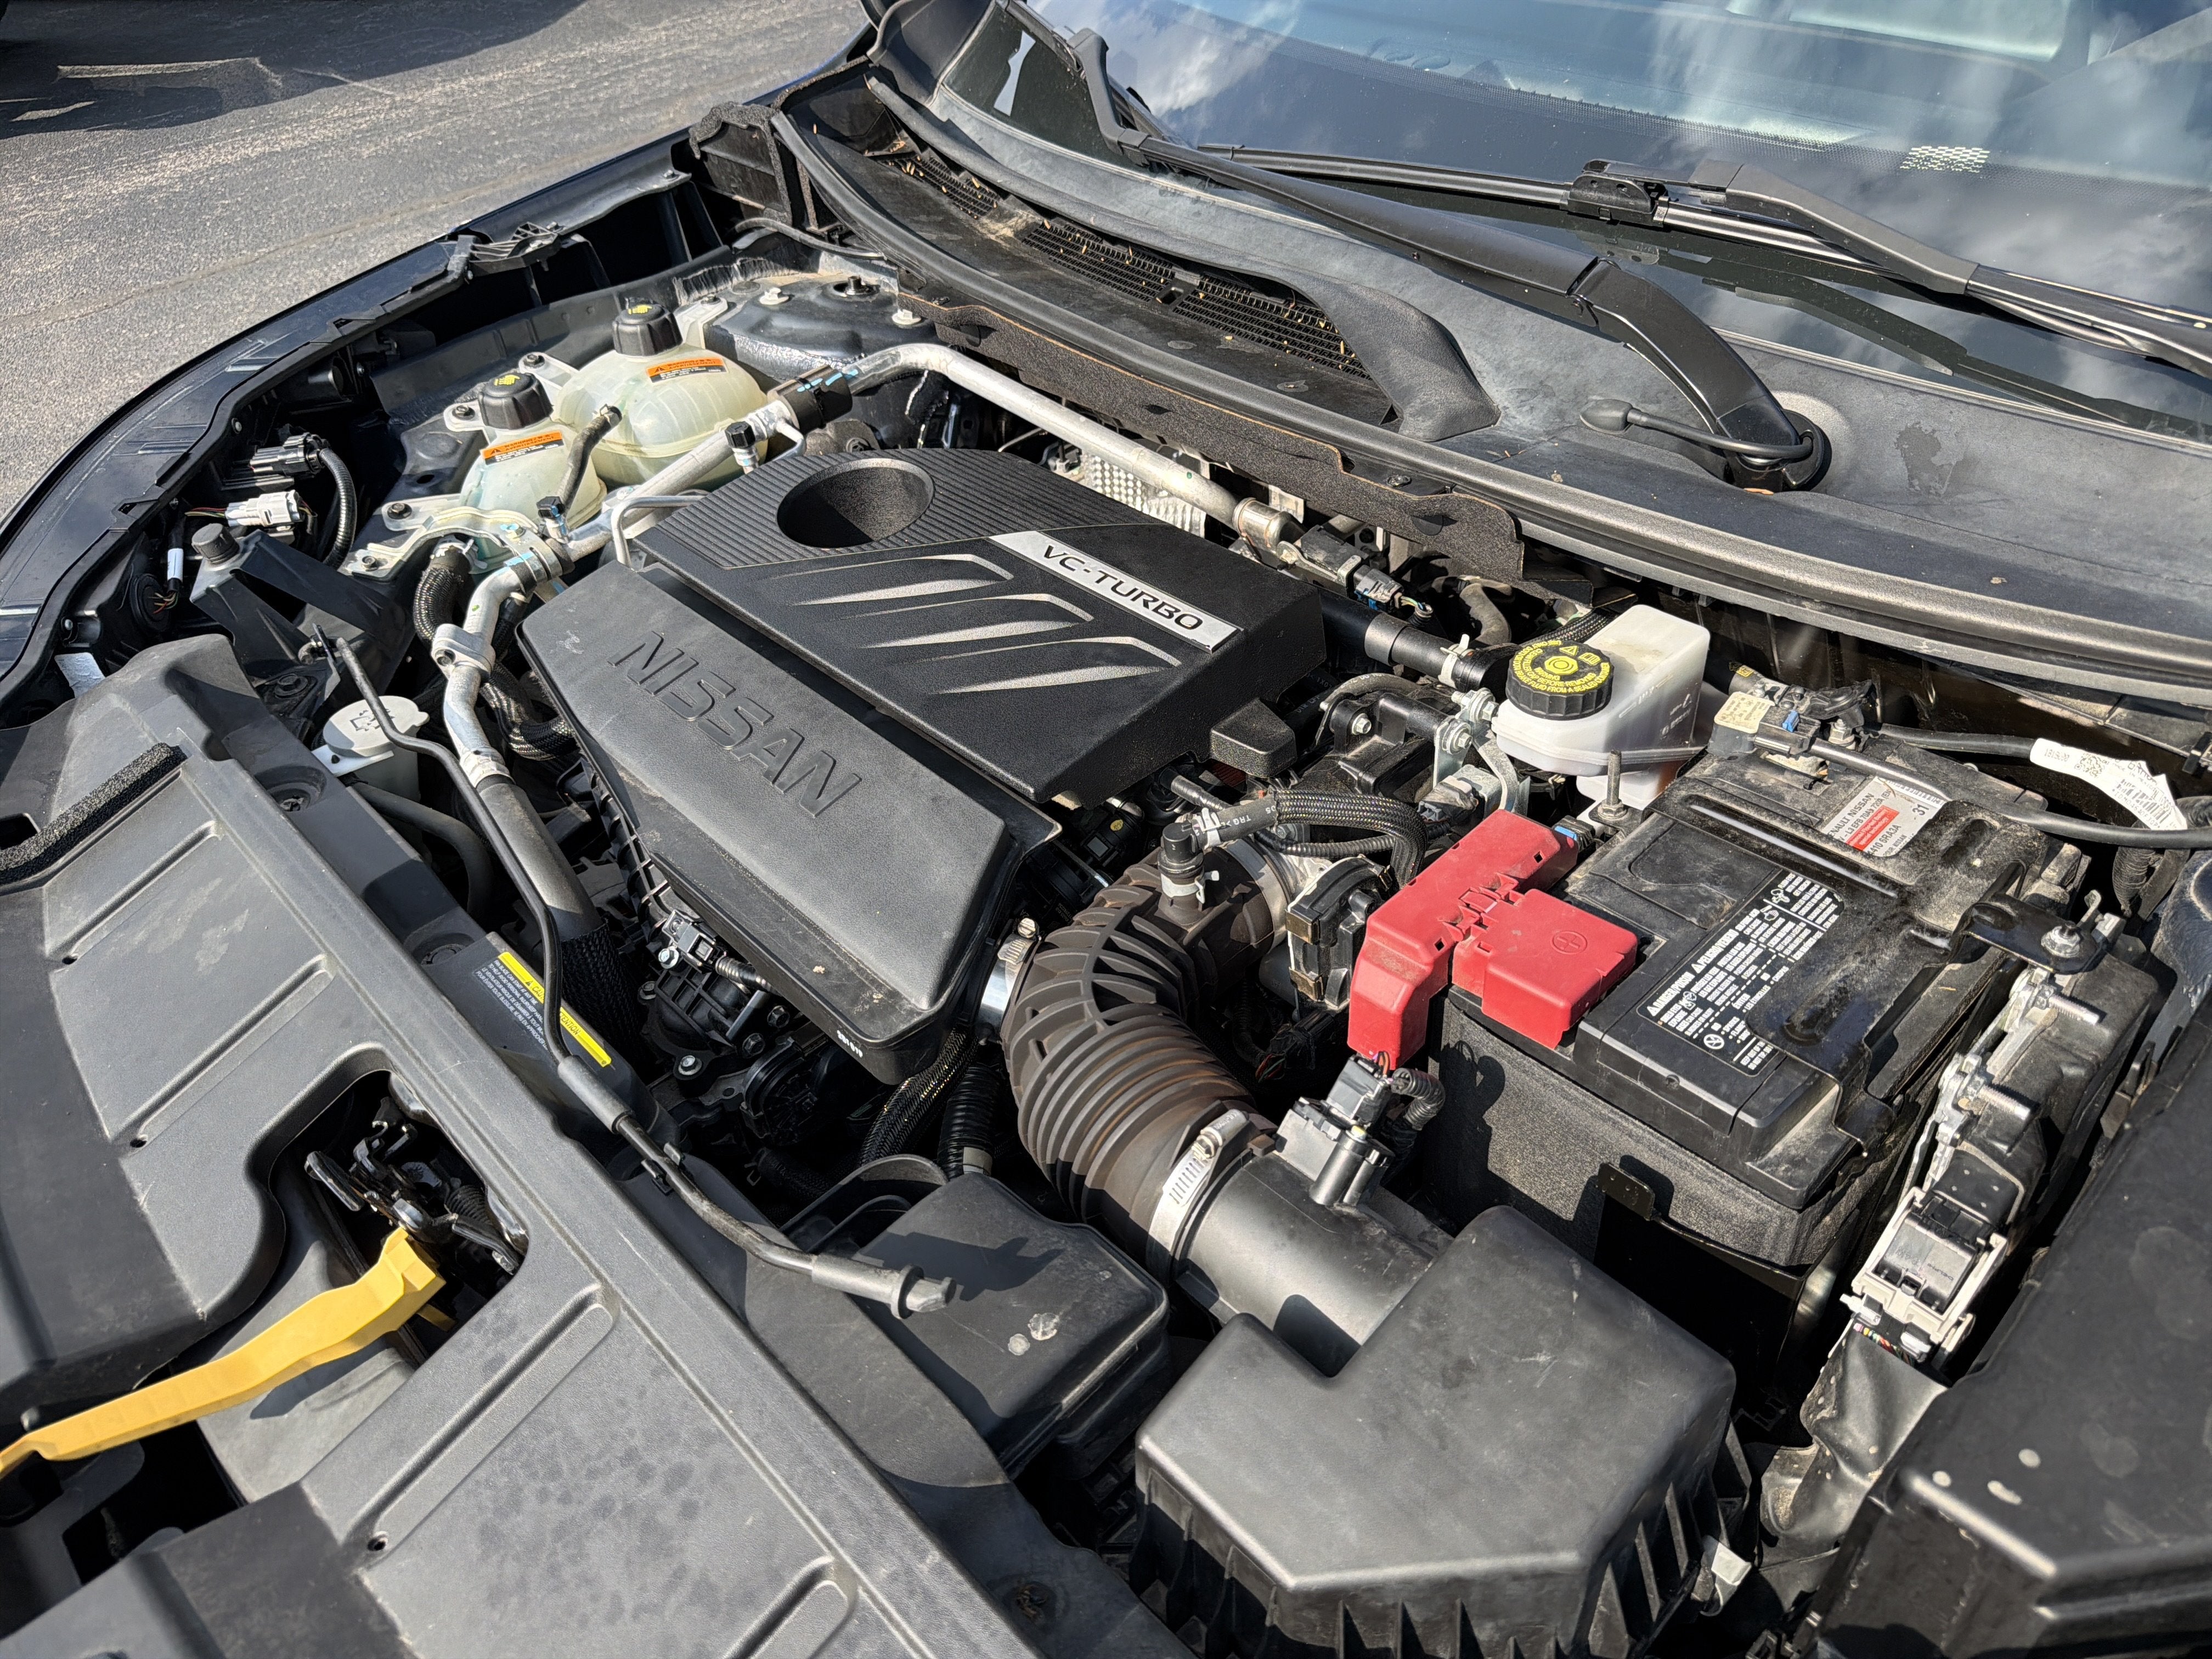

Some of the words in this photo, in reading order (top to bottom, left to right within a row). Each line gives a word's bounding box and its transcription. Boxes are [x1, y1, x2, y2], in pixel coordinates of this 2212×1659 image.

[1042, 544, 1204, 631] VC-TURBO
[1514, 670, 1532, 684] BRAKE
[1528, 680, 1547, 691] FLUID
[1574, 680, 1599, 692] SEALED
[1527, 671, 1540, 680] CAP
[1537, 678, 1565, 687] BEFORE
[1565, 672, 1597, 687] REMOVING
[607, 630, 862, 818] NISSAN
[1848, 793, 1876, 818] NISSAN
[1911, 803, 1929, 816] 31
[1851, 817, 1864, 831] EFB
[1881, 823, 1902, 843] 6RA3A
[560, 1011, 582, 1036] TENTION
[1723, 1017, 1740, 1032] SPARKS
